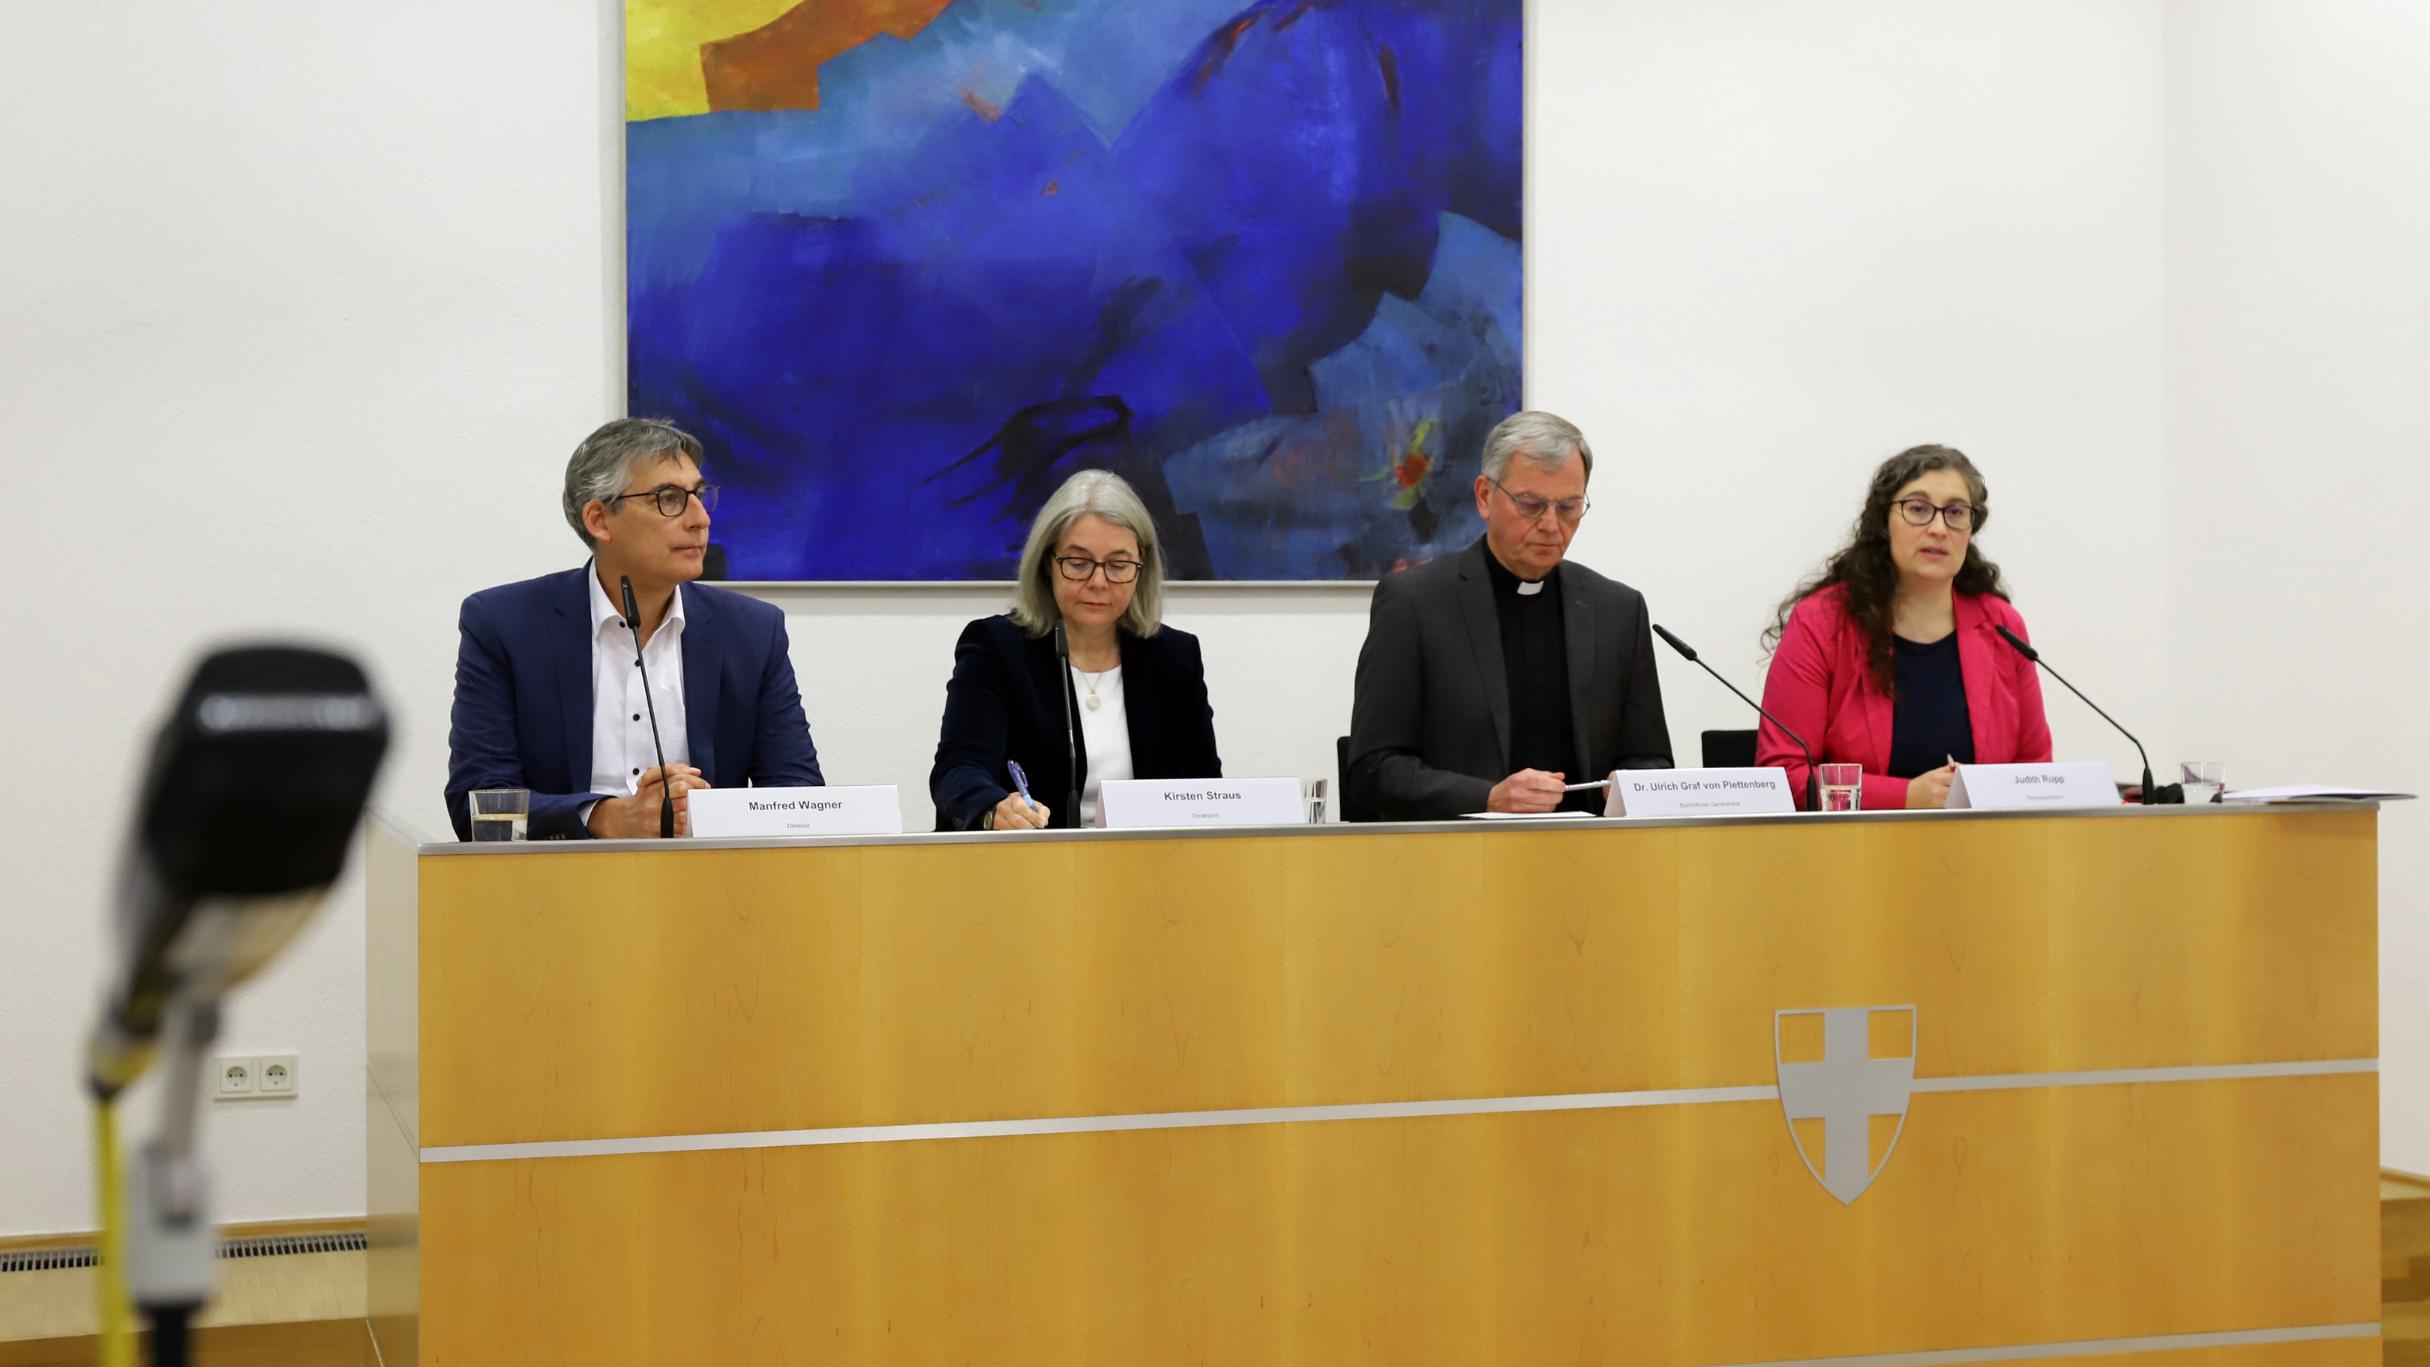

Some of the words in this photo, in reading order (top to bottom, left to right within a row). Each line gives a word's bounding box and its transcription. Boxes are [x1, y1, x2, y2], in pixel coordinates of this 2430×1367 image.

[2015, 775, 2040, 785] Judith
[2042, 774, 2065, 785] Rupp
[1633, 783, 1649, 792] Dr.
[1650, 782, 1679, 792] Ulrich
[1680, 781, 1701, 791] Graf
[1703, 782, 1721, 790] von
[1723, 779, 1777, 791] Plettenberg
[1163, 791, 1204, 801] Kirsten
[1206, 790, 1242, 800] Straus
[748, 801, 796, 811] Manfred
[798, 800, 843, 812] Wagner
